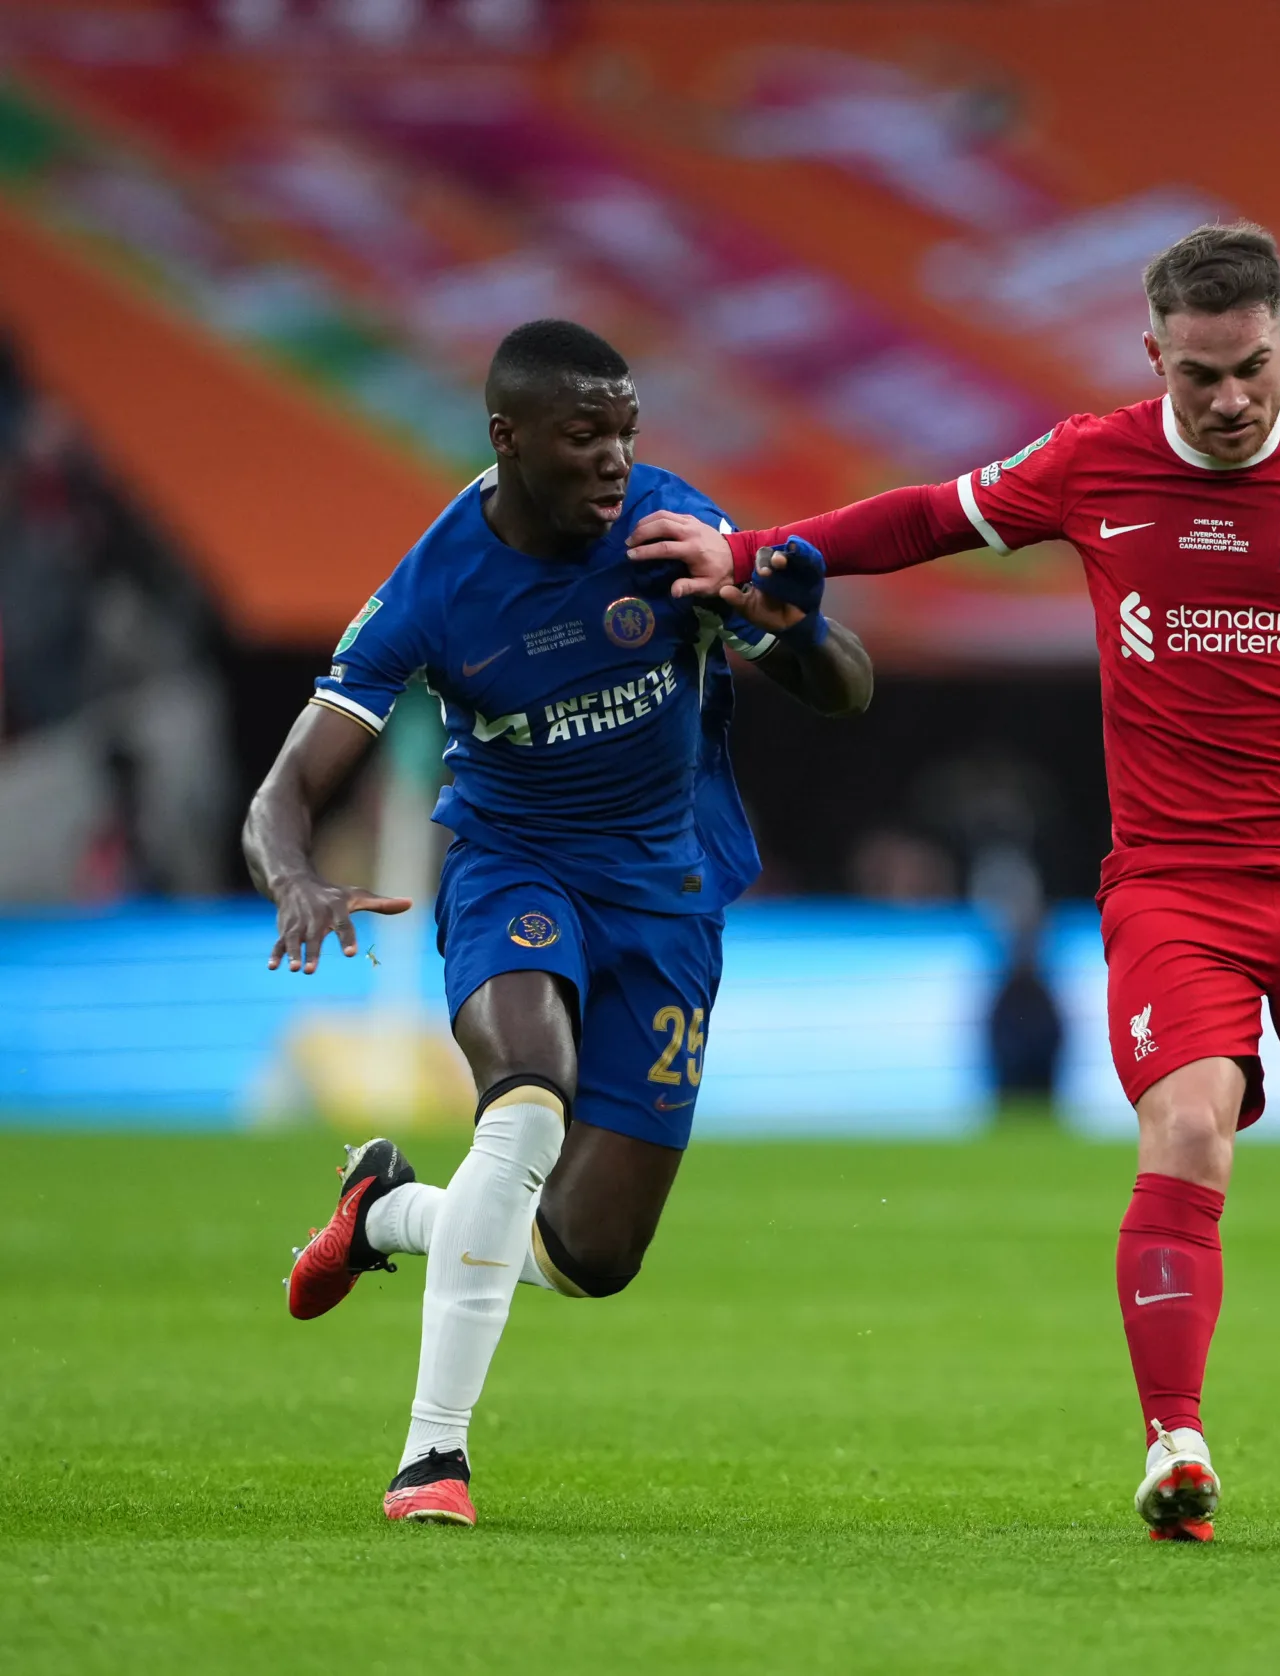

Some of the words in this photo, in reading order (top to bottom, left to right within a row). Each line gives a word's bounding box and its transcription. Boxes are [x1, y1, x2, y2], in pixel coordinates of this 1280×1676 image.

[1193, 518, 1223, 526] CHELSEA
[1189, 531, 1226, 539] LIVERPOOL
[1197, 537, 1231, 546] FEBRUARY
[1179, 543, 1212, 551] CARABAO
[1228, 545, 1248, 553] FINAL
[544, 660, 673, 723] INFINITE
[546, 676, 677, 745] ATHLETE
[647, 1006, 704, 1087] 25
